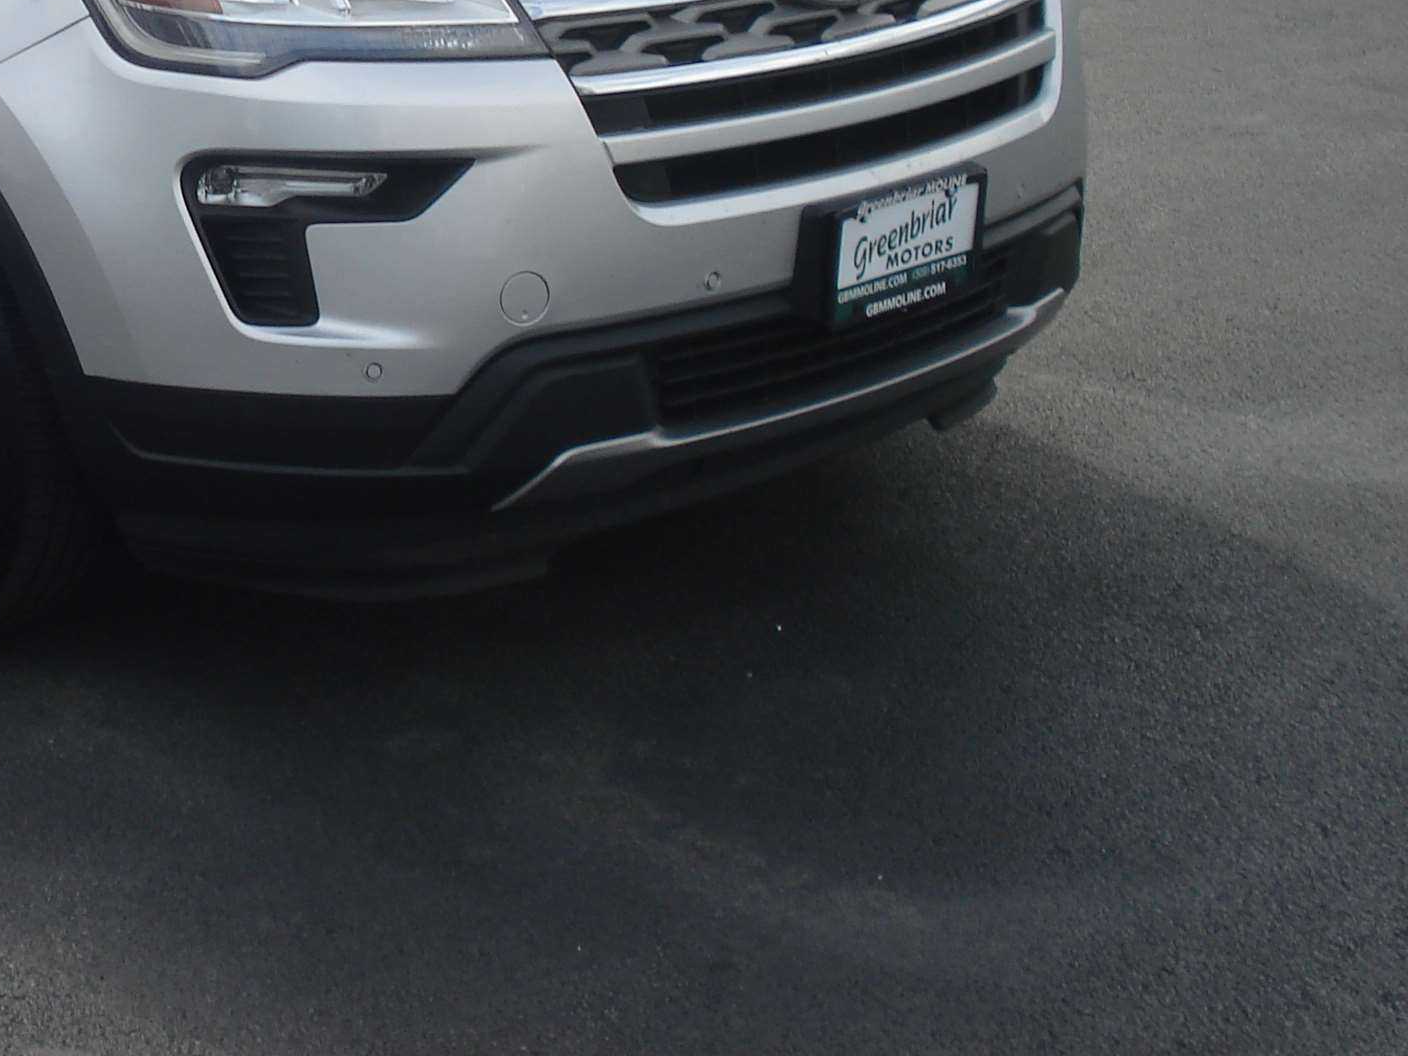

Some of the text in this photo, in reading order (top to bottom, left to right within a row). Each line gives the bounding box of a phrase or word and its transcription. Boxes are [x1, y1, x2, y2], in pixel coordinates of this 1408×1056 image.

[854, 195, 958, 280] Greenbriar
[886, 236, 954, 270] MOTORS
[866, 282, 946, 317] GBMMOLINE.COM
